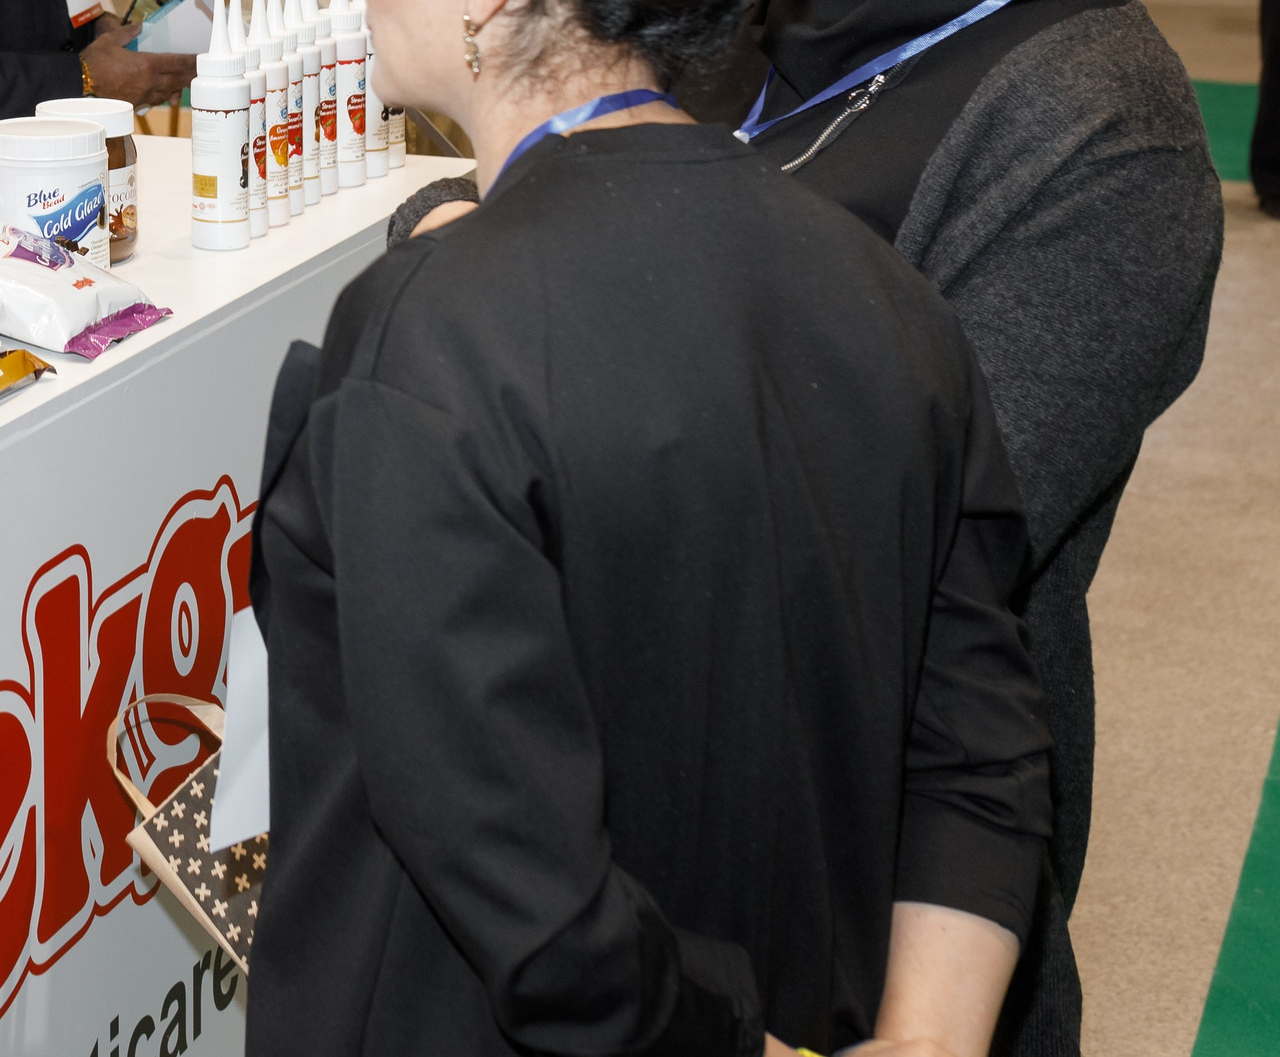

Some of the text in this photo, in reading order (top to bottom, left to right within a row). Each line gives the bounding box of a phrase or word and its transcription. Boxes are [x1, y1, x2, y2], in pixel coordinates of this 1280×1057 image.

[26, 188, 60, 208] Blue
[42, 193, 65, 210] Bead
[43, 191, 103, 239] Cold Glaze
